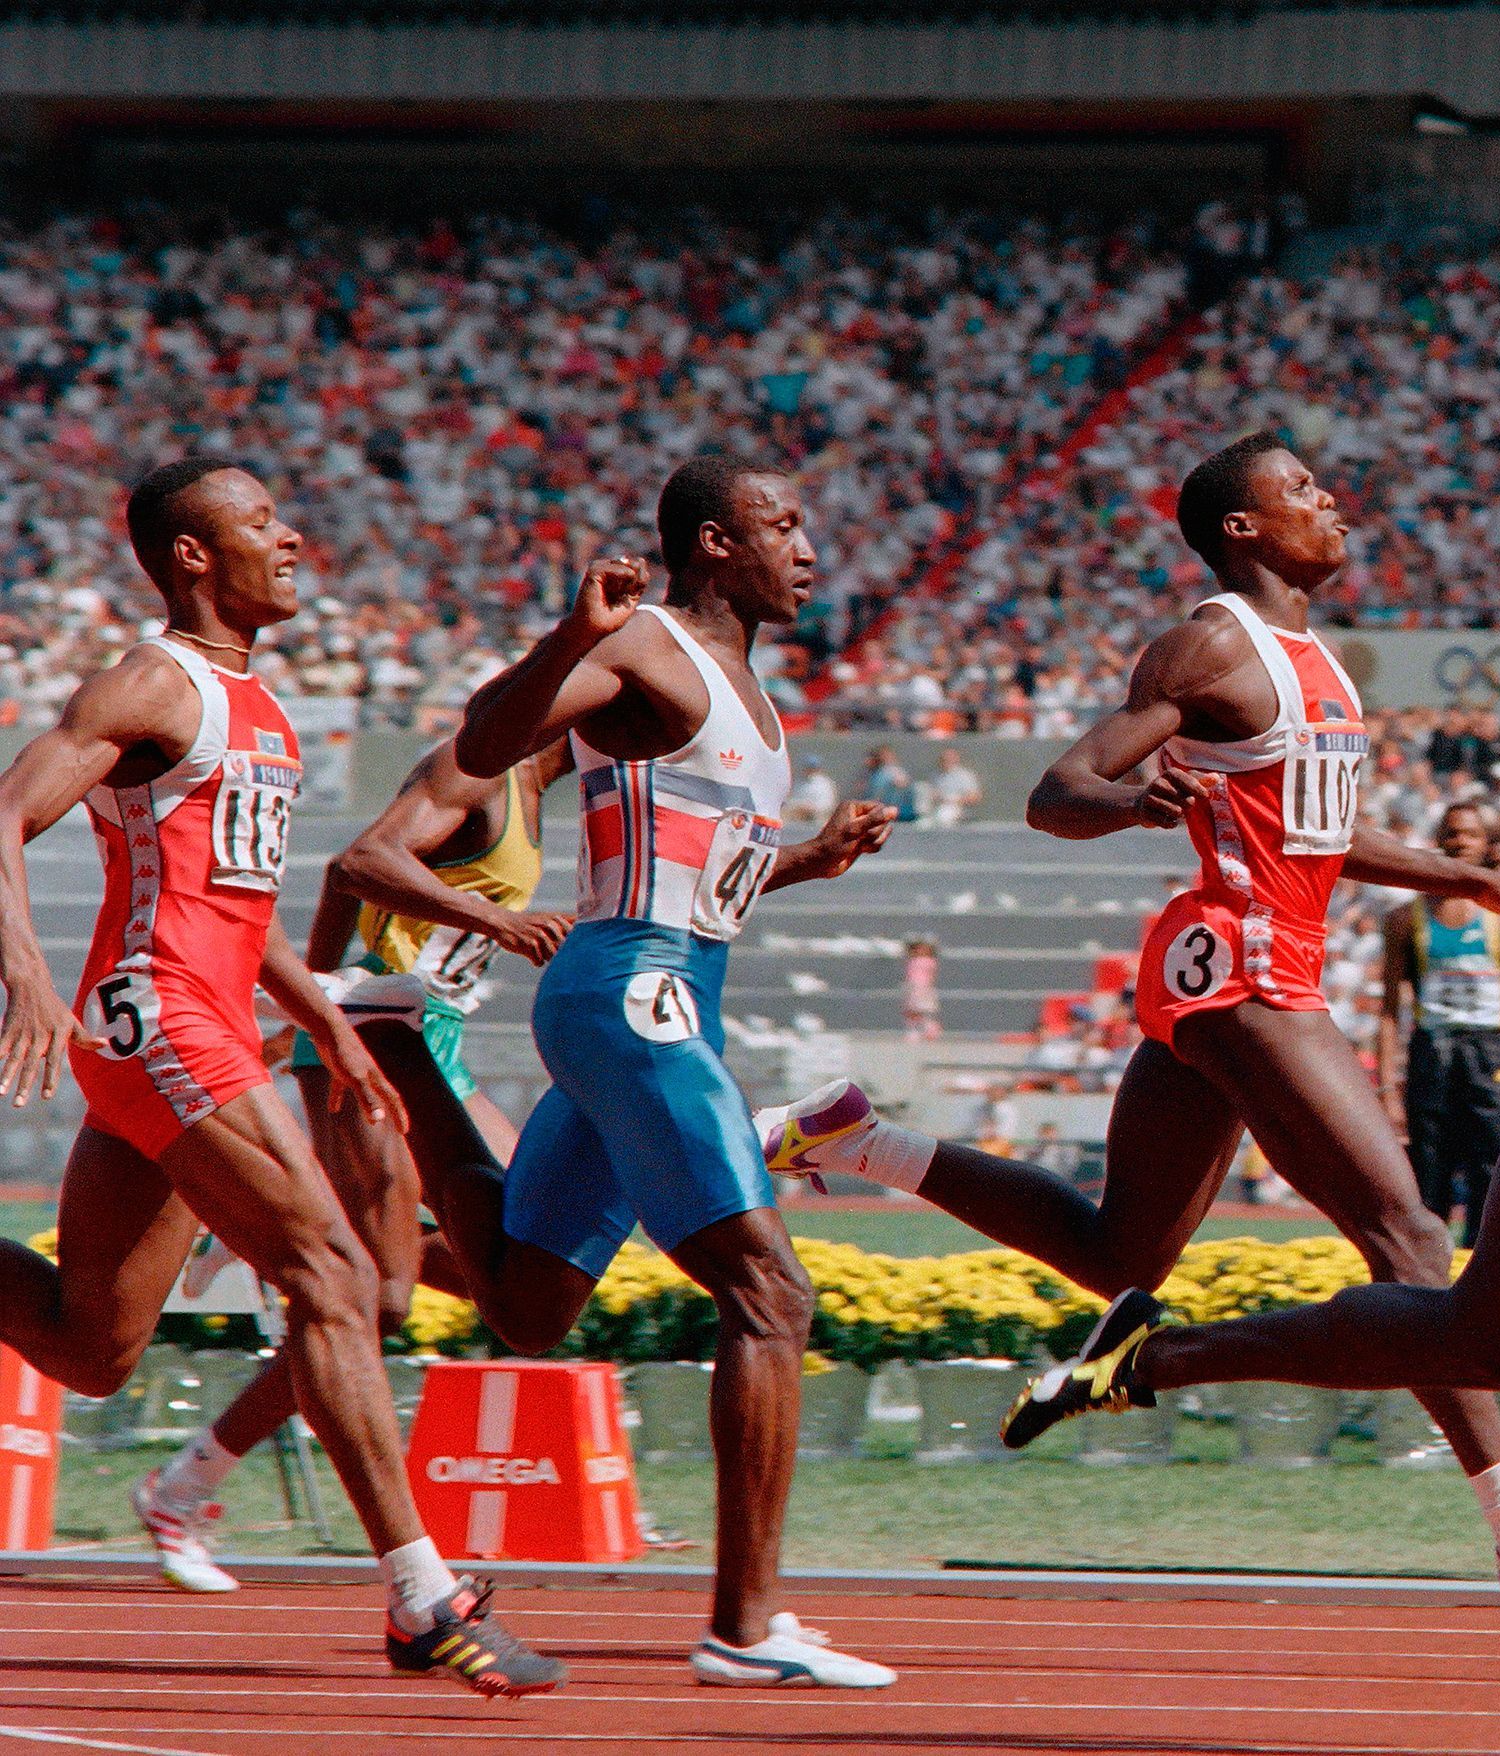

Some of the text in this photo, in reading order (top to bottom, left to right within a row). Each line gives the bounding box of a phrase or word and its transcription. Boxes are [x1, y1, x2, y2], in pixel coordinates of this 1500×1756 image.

[223, 789, 291, 868] 113
[1294, 756, 1361, 830] 110
[1176, 927, 1216, 997] 3
[96, 976, 143, 1057] 5
[426, 1456, 561, 1485] OMEGA
